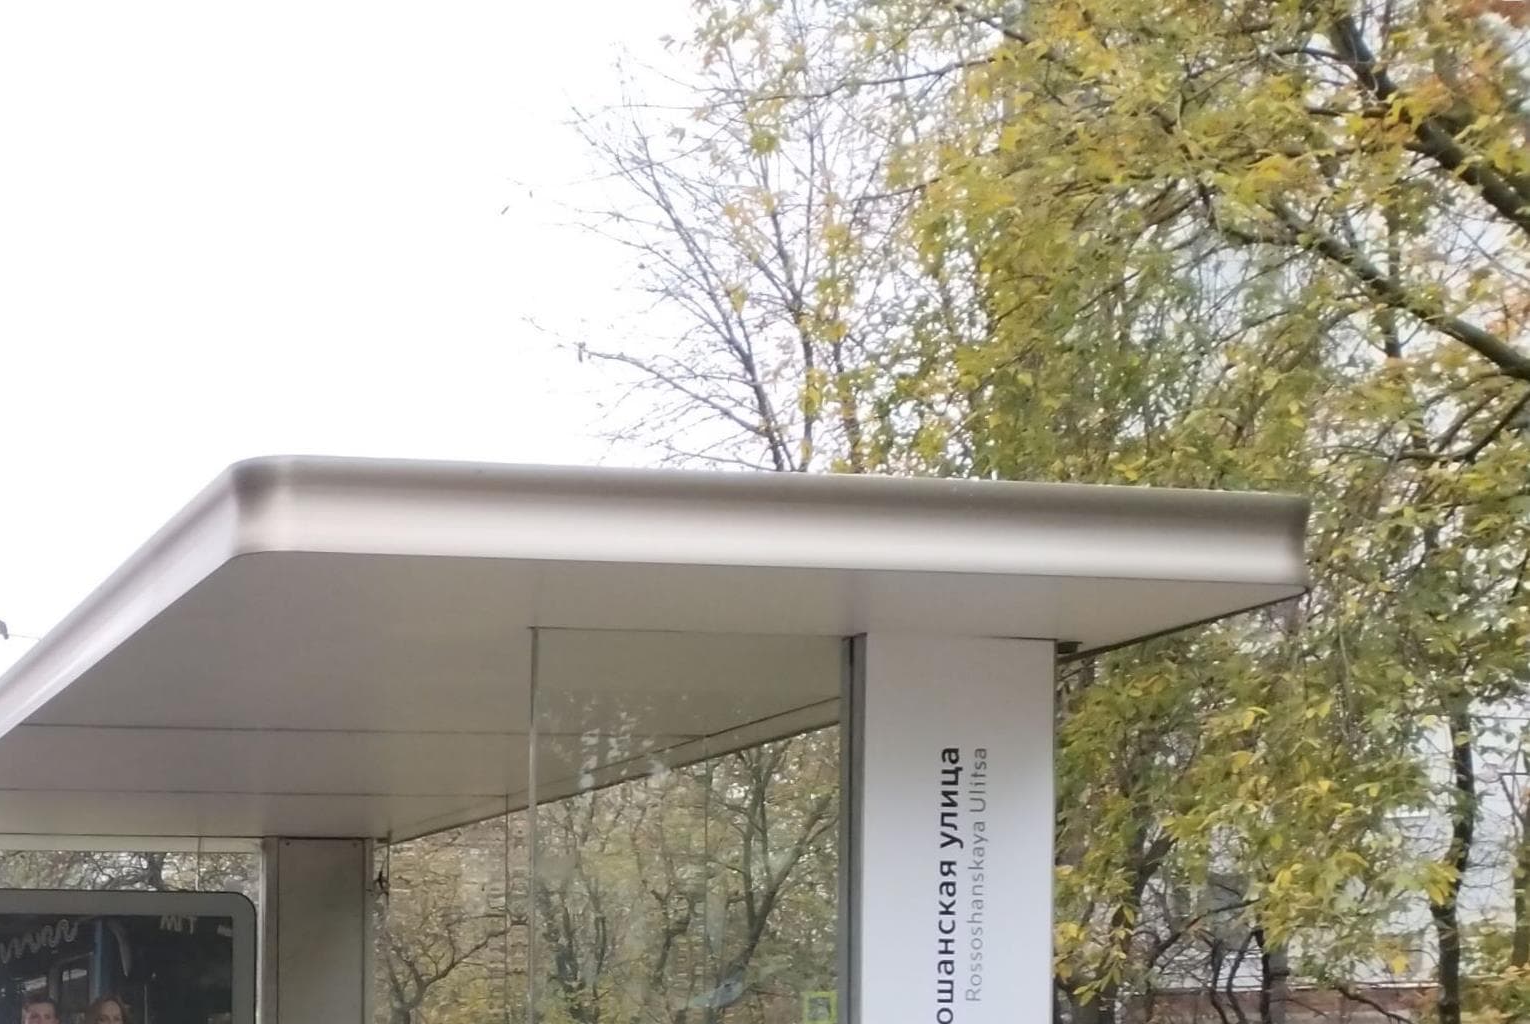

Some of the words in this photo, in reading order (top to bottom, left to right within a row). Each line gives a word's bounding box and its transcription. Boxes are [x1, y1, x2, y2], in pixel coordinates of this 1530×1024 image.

[939, 747, 964, 849] улица
[968, 747, 988, 813] Ulitsa
[965, 821, 989, 1002] Rossoshanskaya
